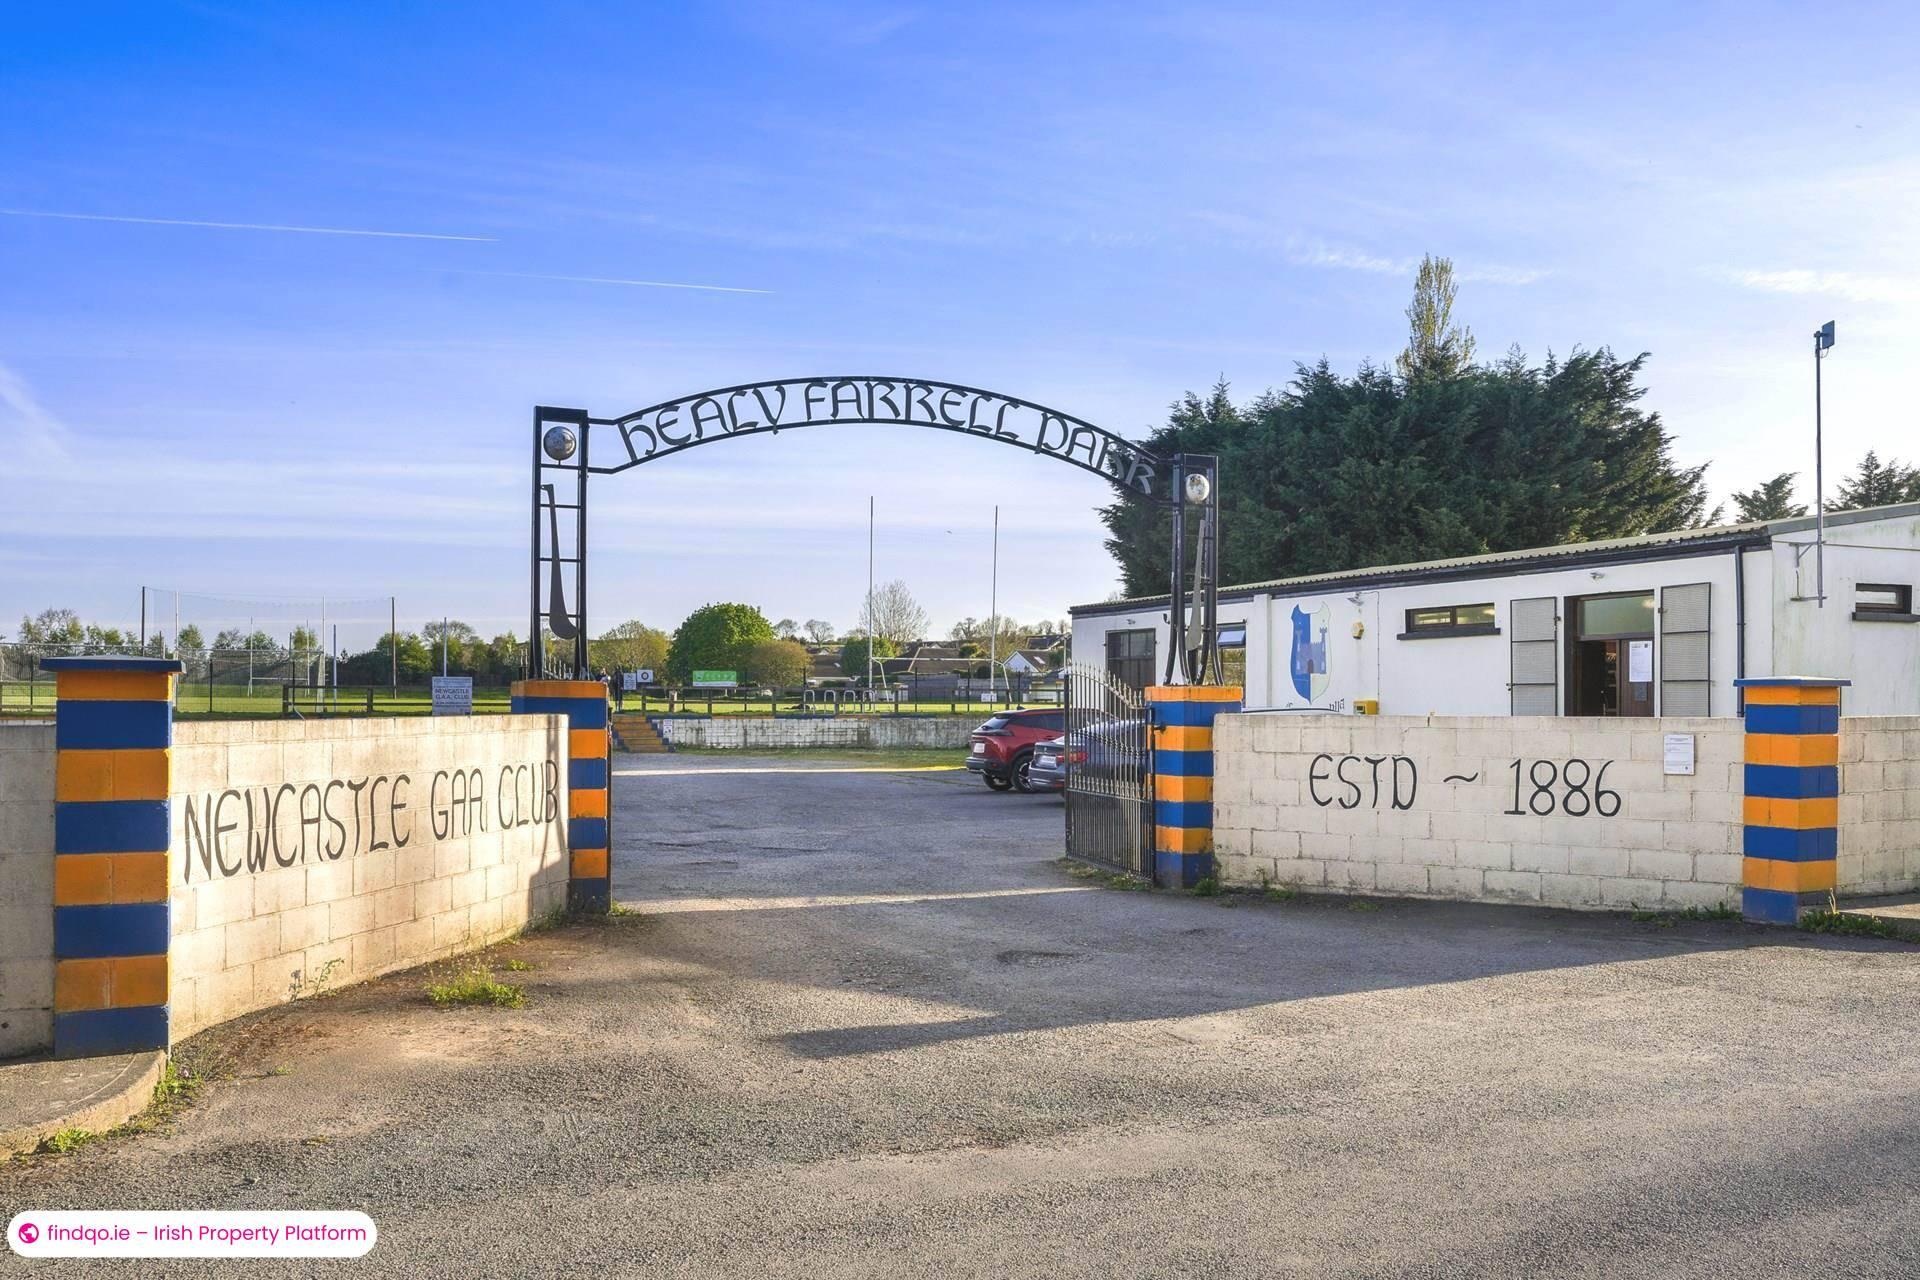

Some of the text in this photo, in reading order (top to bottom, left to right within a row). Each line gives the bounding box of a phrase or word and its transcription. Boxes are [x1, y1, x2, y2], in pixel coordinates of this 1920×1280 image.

[804, 380, 1021, 441] FARRELL
[1034, 411, 1158, 495] PARK
[184, 759, 559, 884] NEWCASTLE GAA CLUB
[1309, 753, 1418, 811] ESTD
[1503, 758, 1622, 818] 1886
